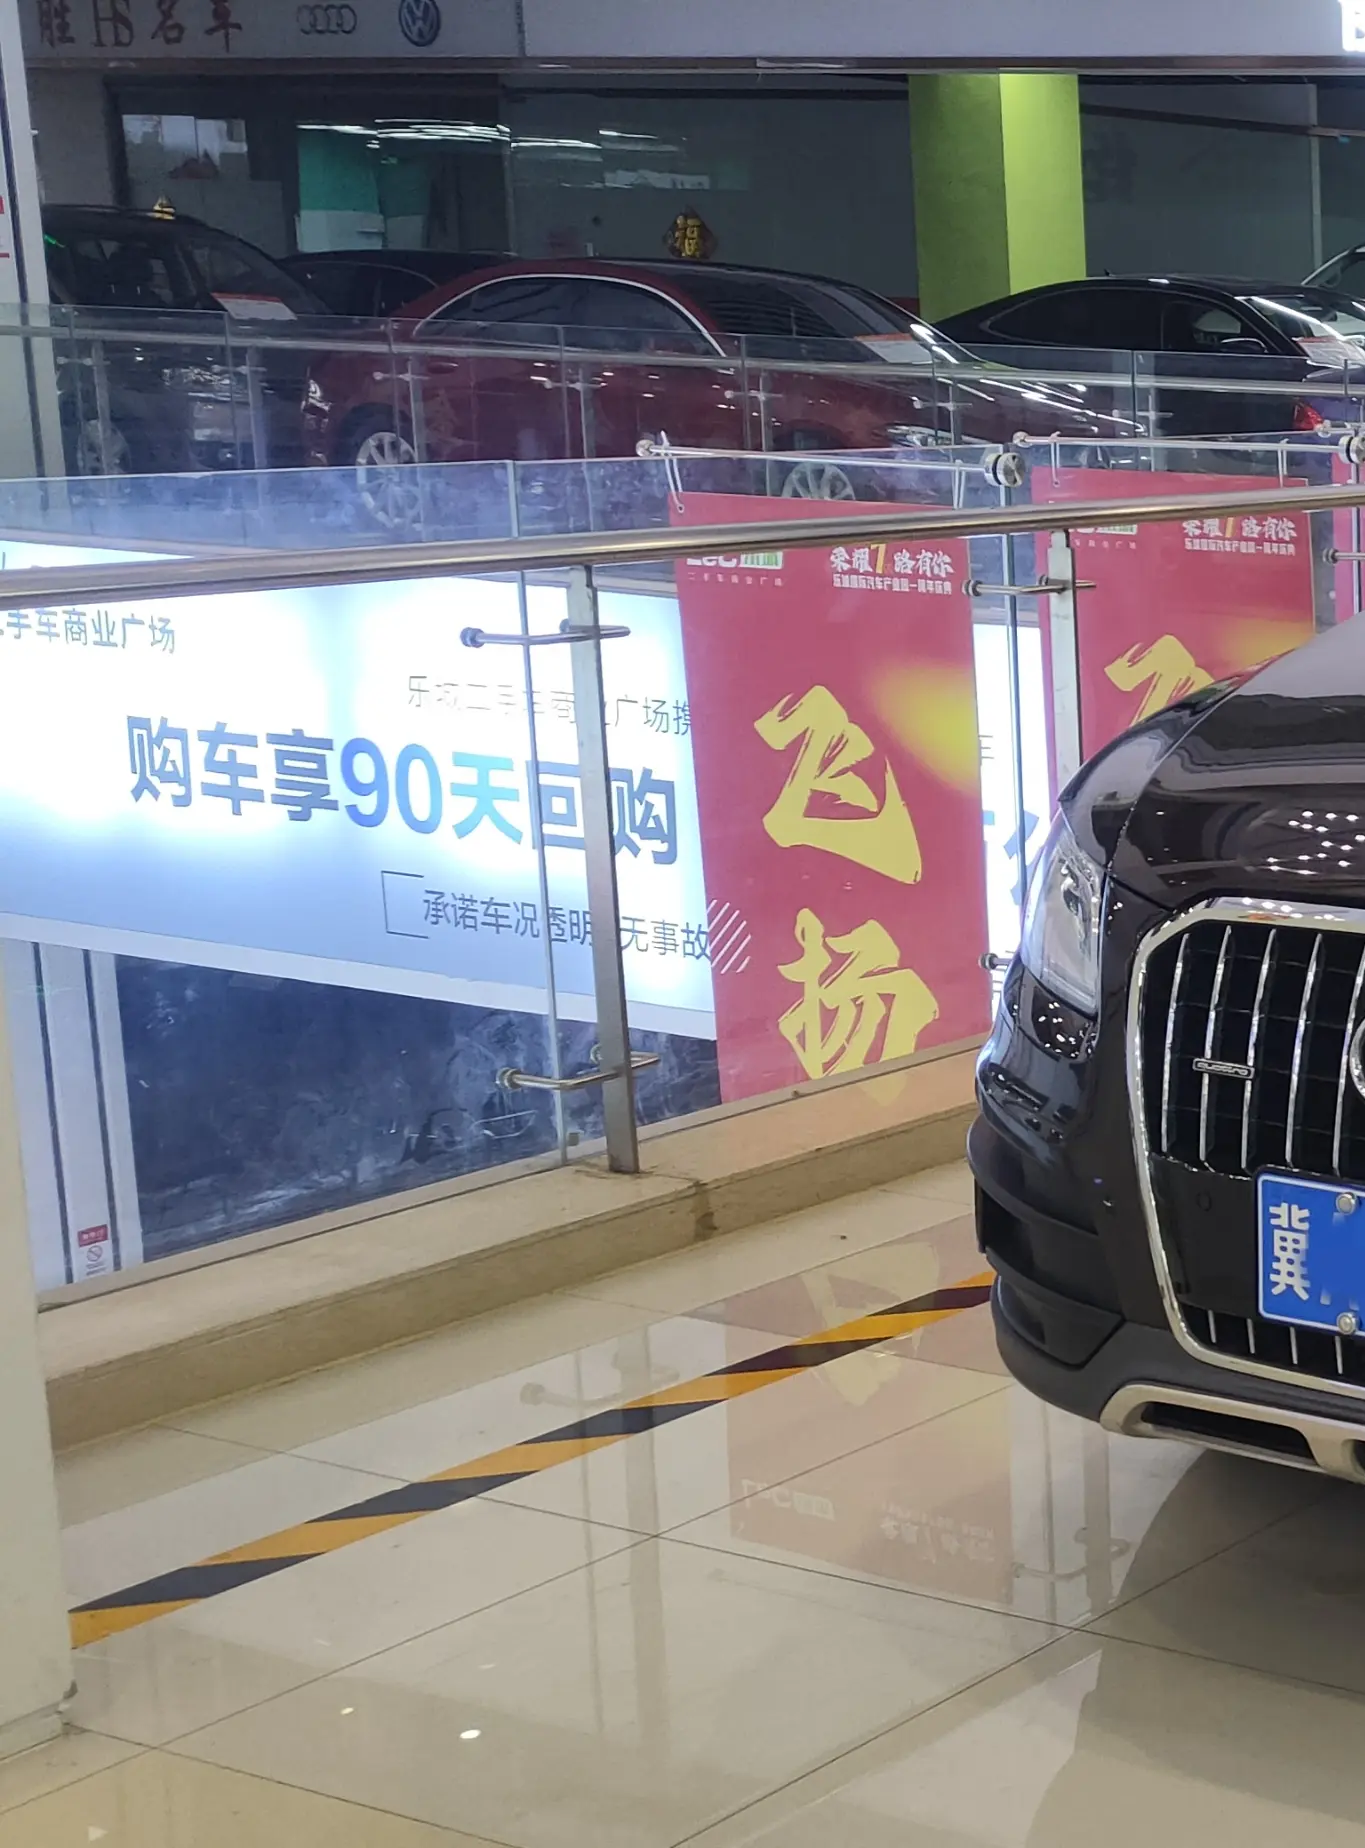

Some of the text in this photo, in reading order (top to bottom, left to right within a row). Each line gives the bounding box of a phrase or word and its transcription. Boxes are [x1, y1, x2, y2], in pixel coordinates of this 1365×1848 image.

[0, 608, 175, 654] 手车商业广场
[126, 715, 678, 866] 购车享90天回购
